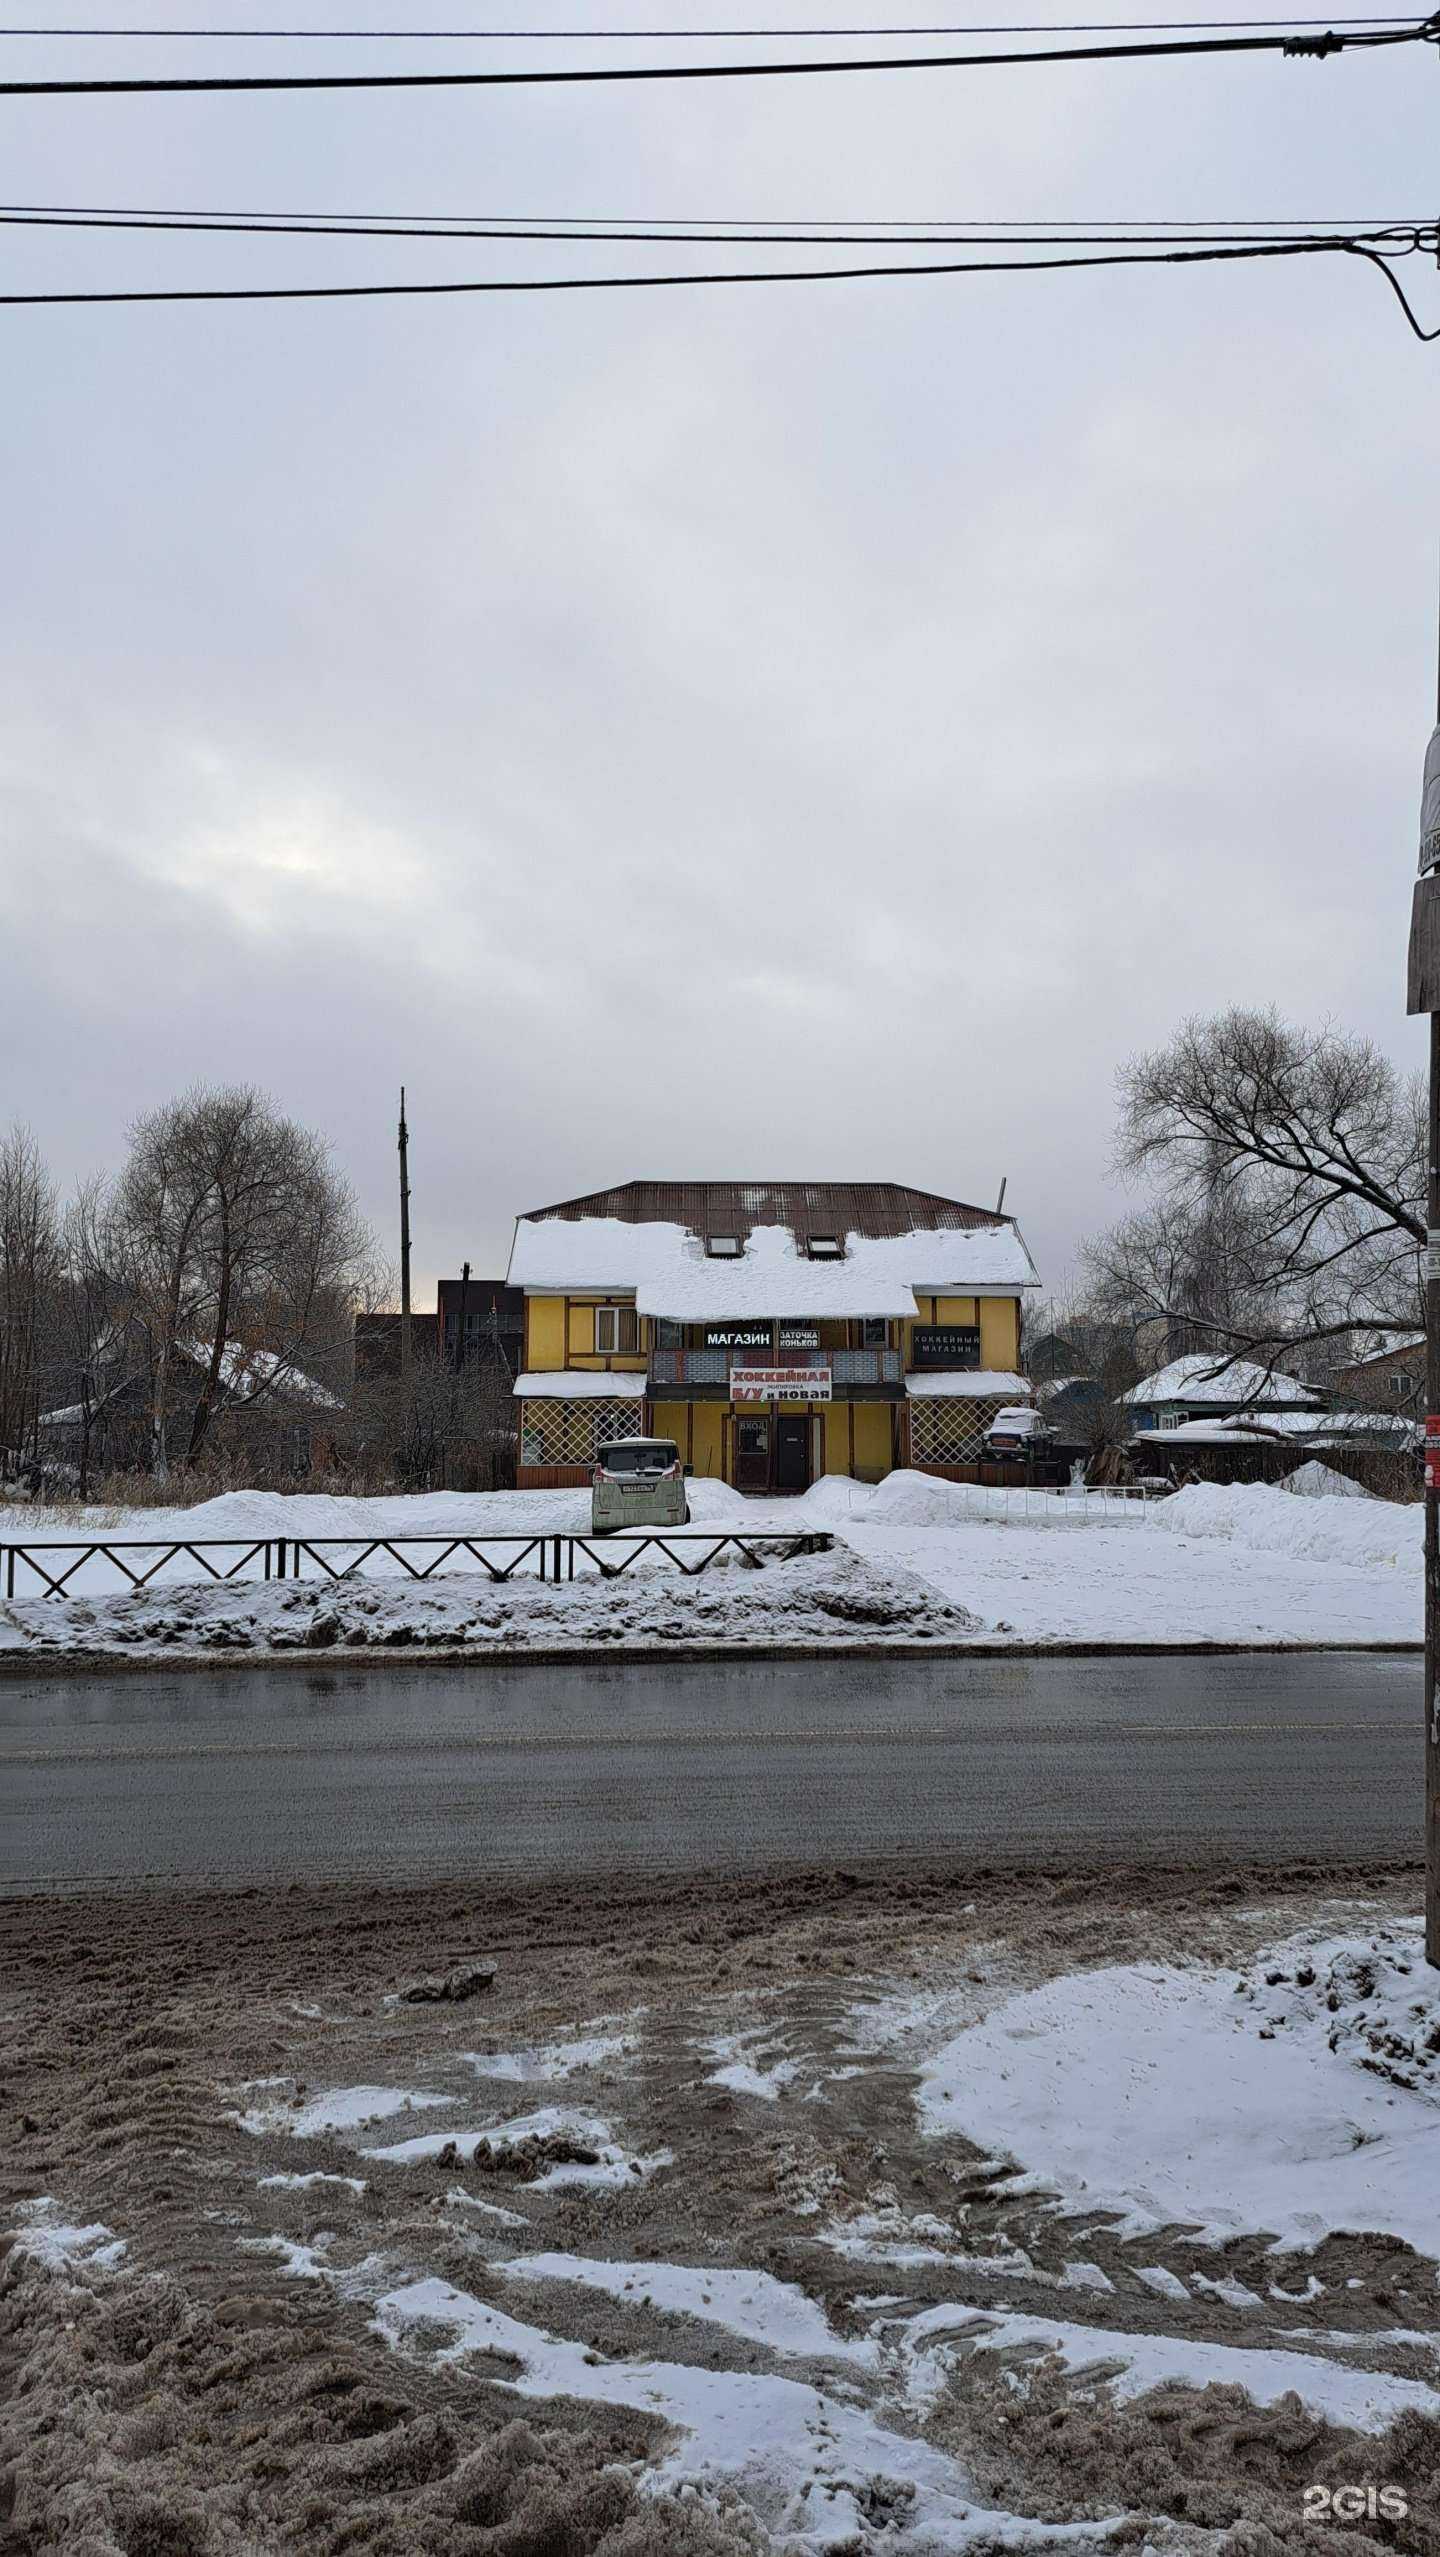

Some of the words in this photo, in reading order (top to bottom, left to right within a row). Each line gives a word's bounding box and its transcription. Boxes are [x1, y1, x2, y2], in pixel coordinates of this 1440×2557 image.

[707, 1333, 770, 1345] МАГАЗИН
[780, 1331, 818, 1339] ЗАТОЧКА
[914, 1335, 980, 1344] ХОККЕЙНЫЙ
[780, 1339, 818, 1347] КОНЬКОВ
[922, 1345, 971, 1353] МАГАЗИН
[732, 1370, 830, 1382] ХОККЕЙНАЯ
[732, 1387, 763, 1400] Б/У
[739, 1421, 768, 1432] ВХОД
